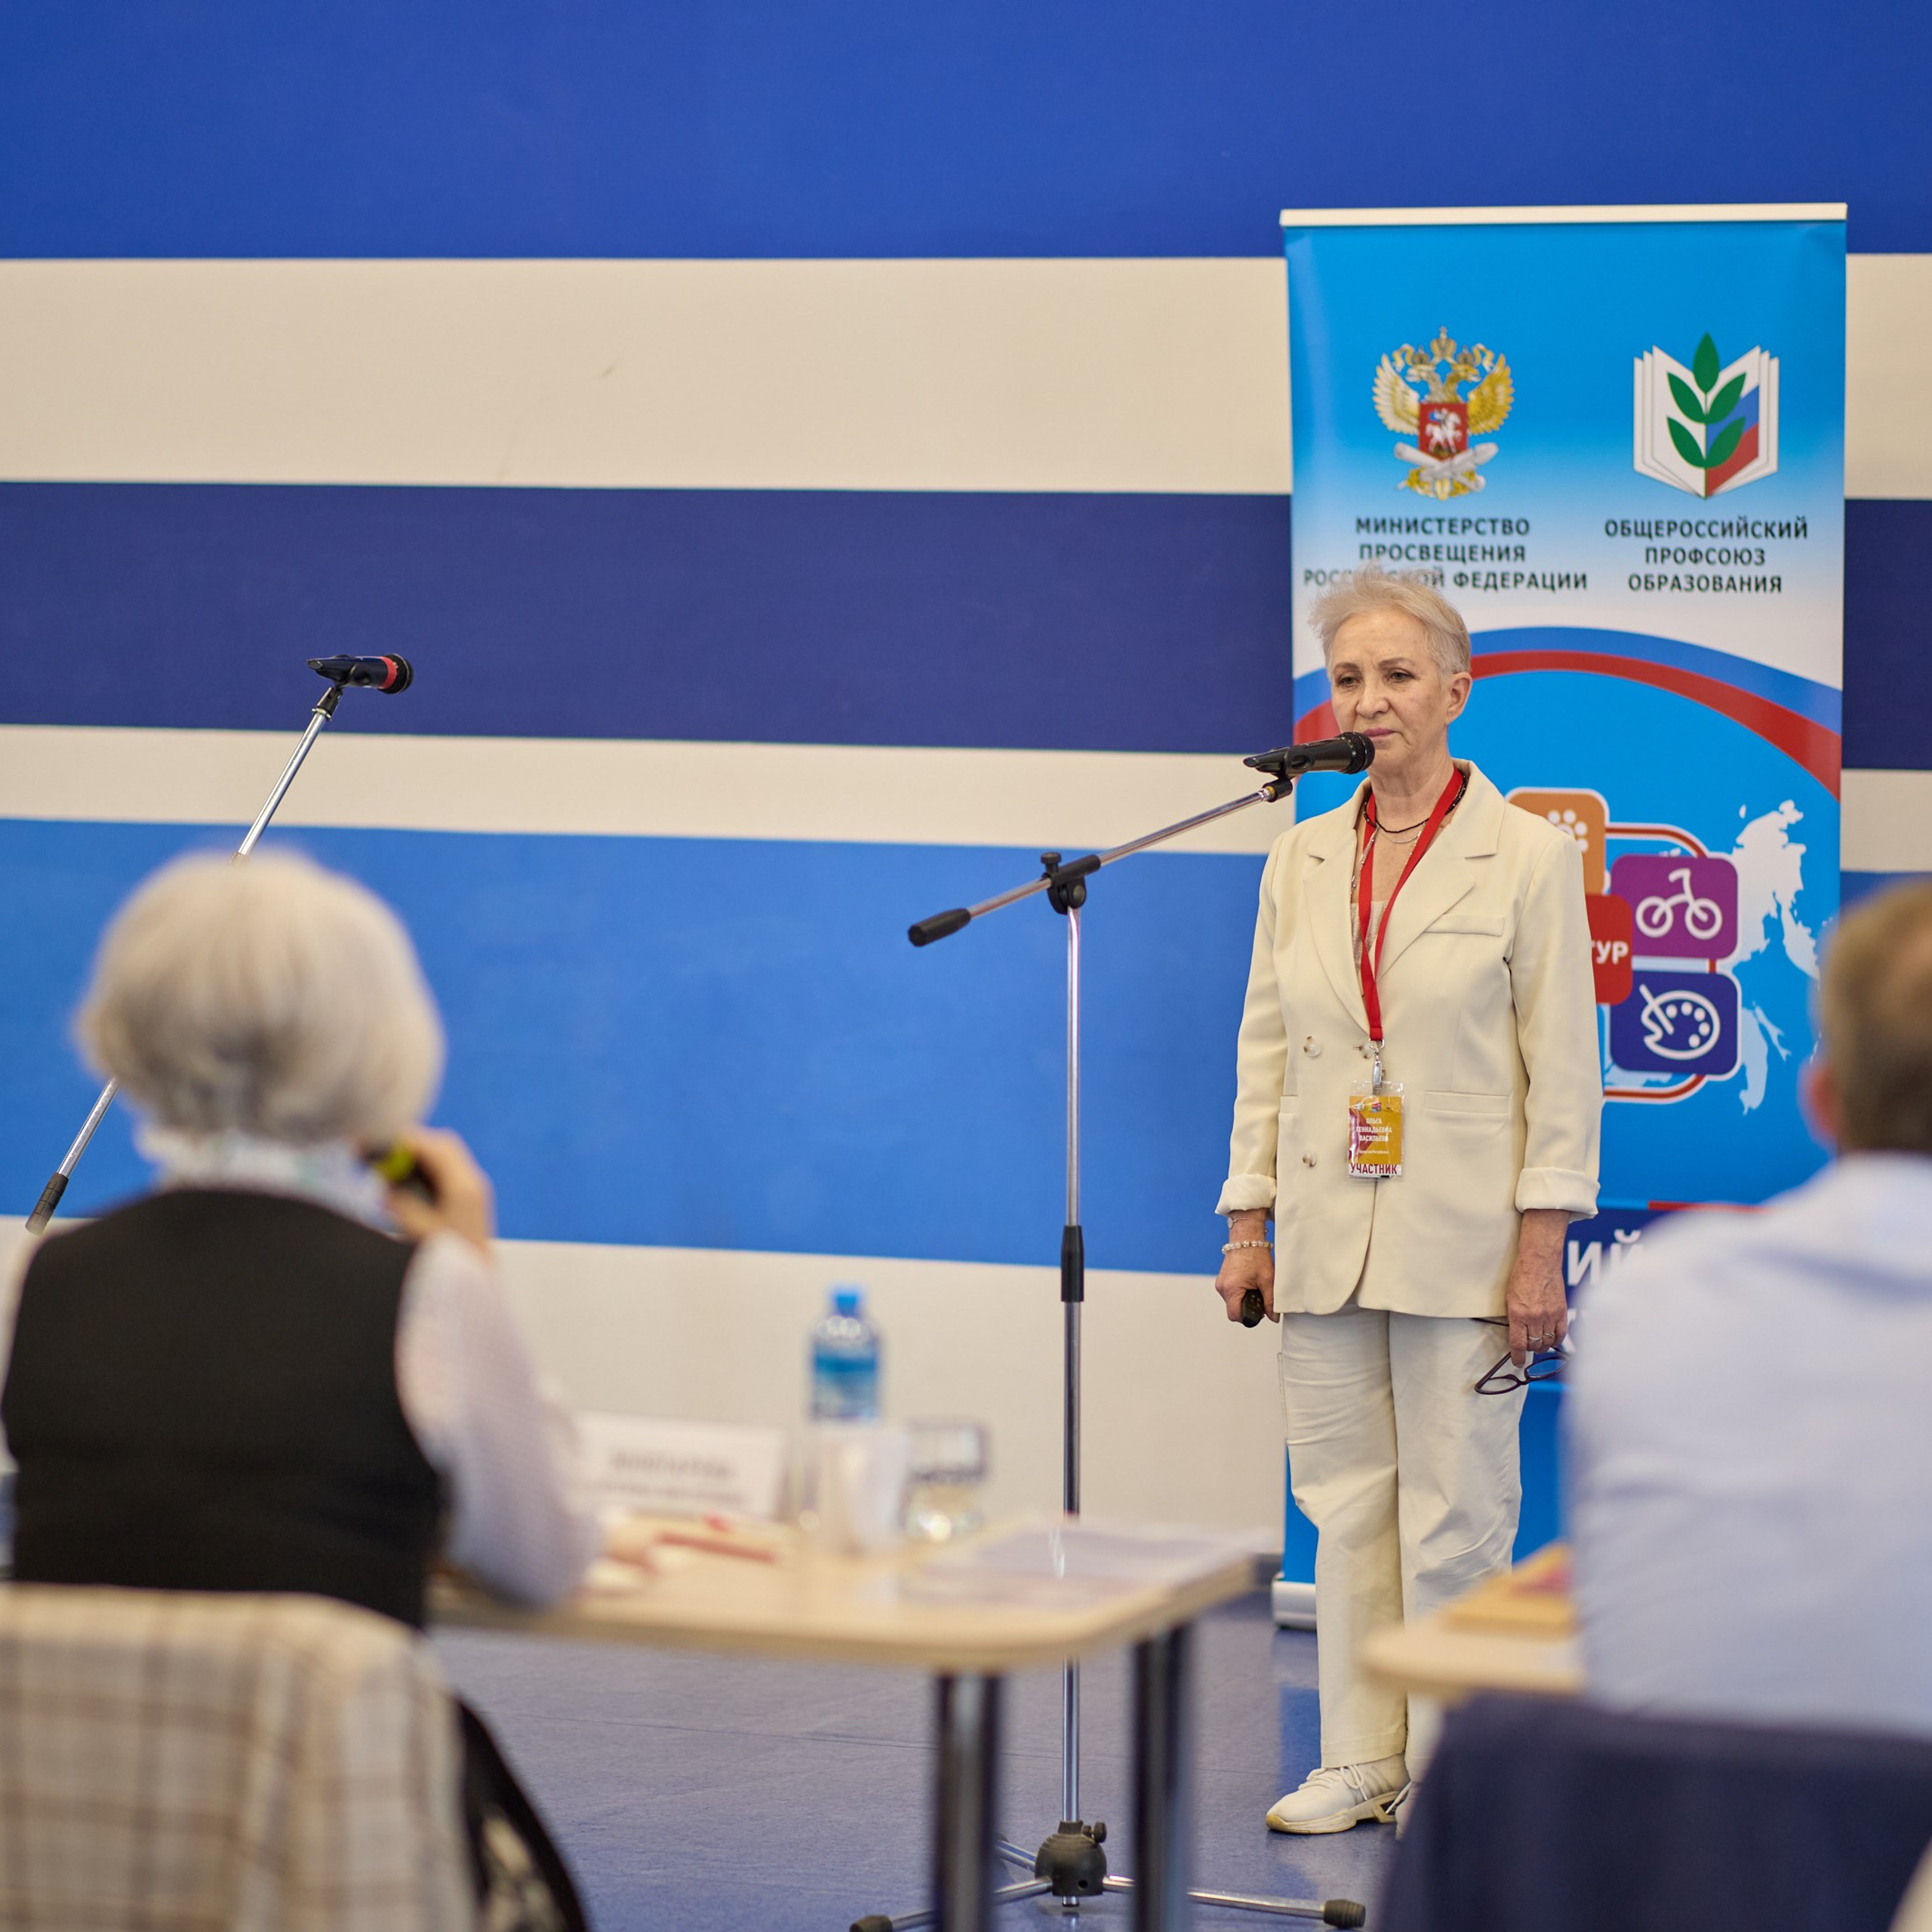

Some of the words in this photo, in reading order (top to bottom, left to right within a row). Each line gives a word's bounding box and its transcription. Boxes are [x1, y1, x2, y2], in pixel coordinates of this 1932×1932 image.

[1356, 517, 1530, 536] МИНИСТЕРСТВО
[1604, 515, 1807, 540] ОБЩЕРОССИЙСКИЙ
[1360, 544, 1525, 564] ПРОСВЕЩЕНИЯ
[1645, 547, 1765, 565] ПРОФСОЮЗ
[1454, 571, 1587, 592] ФЕДЕРАЦИИ
[1629, 574, 1782, 593] ОБРАЗОВАНИЯ
[1592, 940, 1629, 964] УР
[1351, 1164, 1397, 1174] УЧАСТНИК
